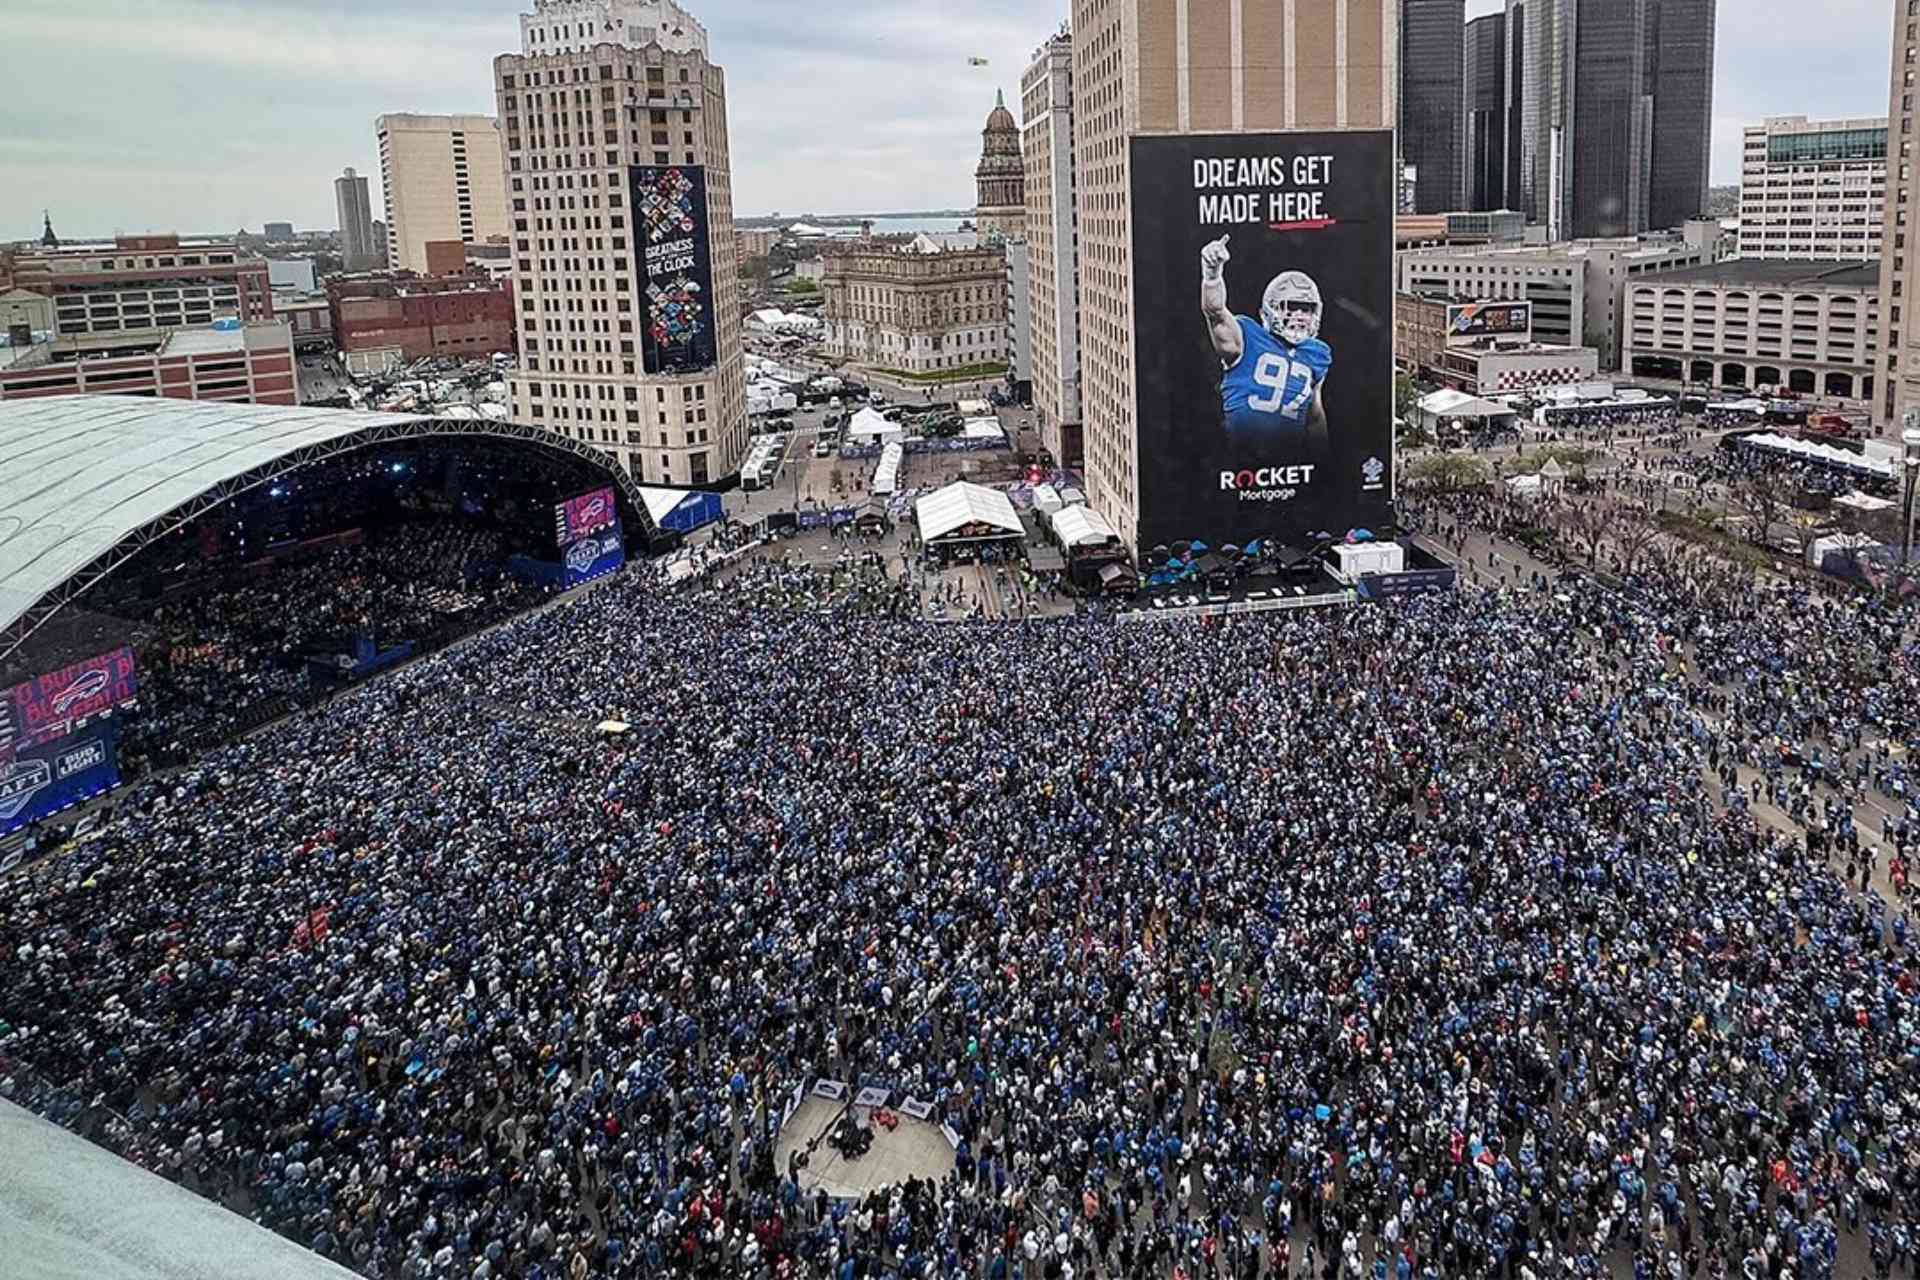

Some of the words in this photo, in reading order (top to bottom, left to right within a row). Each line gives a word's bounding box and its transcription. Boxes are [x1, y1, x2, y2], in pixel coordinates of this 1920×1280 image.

[1193, 156, 1285, 188] DREAMS
[1292, 155, 1334, 185] GET
[1199, 194, 1261, 224] MADE
[1269, 191, 1329, 221] HERE.
[645, 238, 695, 259] GREATNESS
[647, 262, 664, 276] THE
[664, 255, 696, 273] CLOCK
[1248, 352, 1313, 420] 97
[1220, 464, 1315, 490] ROCKET
[1239, 487, 1297, 502] Mortgage
[60, 751, 101, 775] LIGHT
[65, 747, 95, 765] BUD
